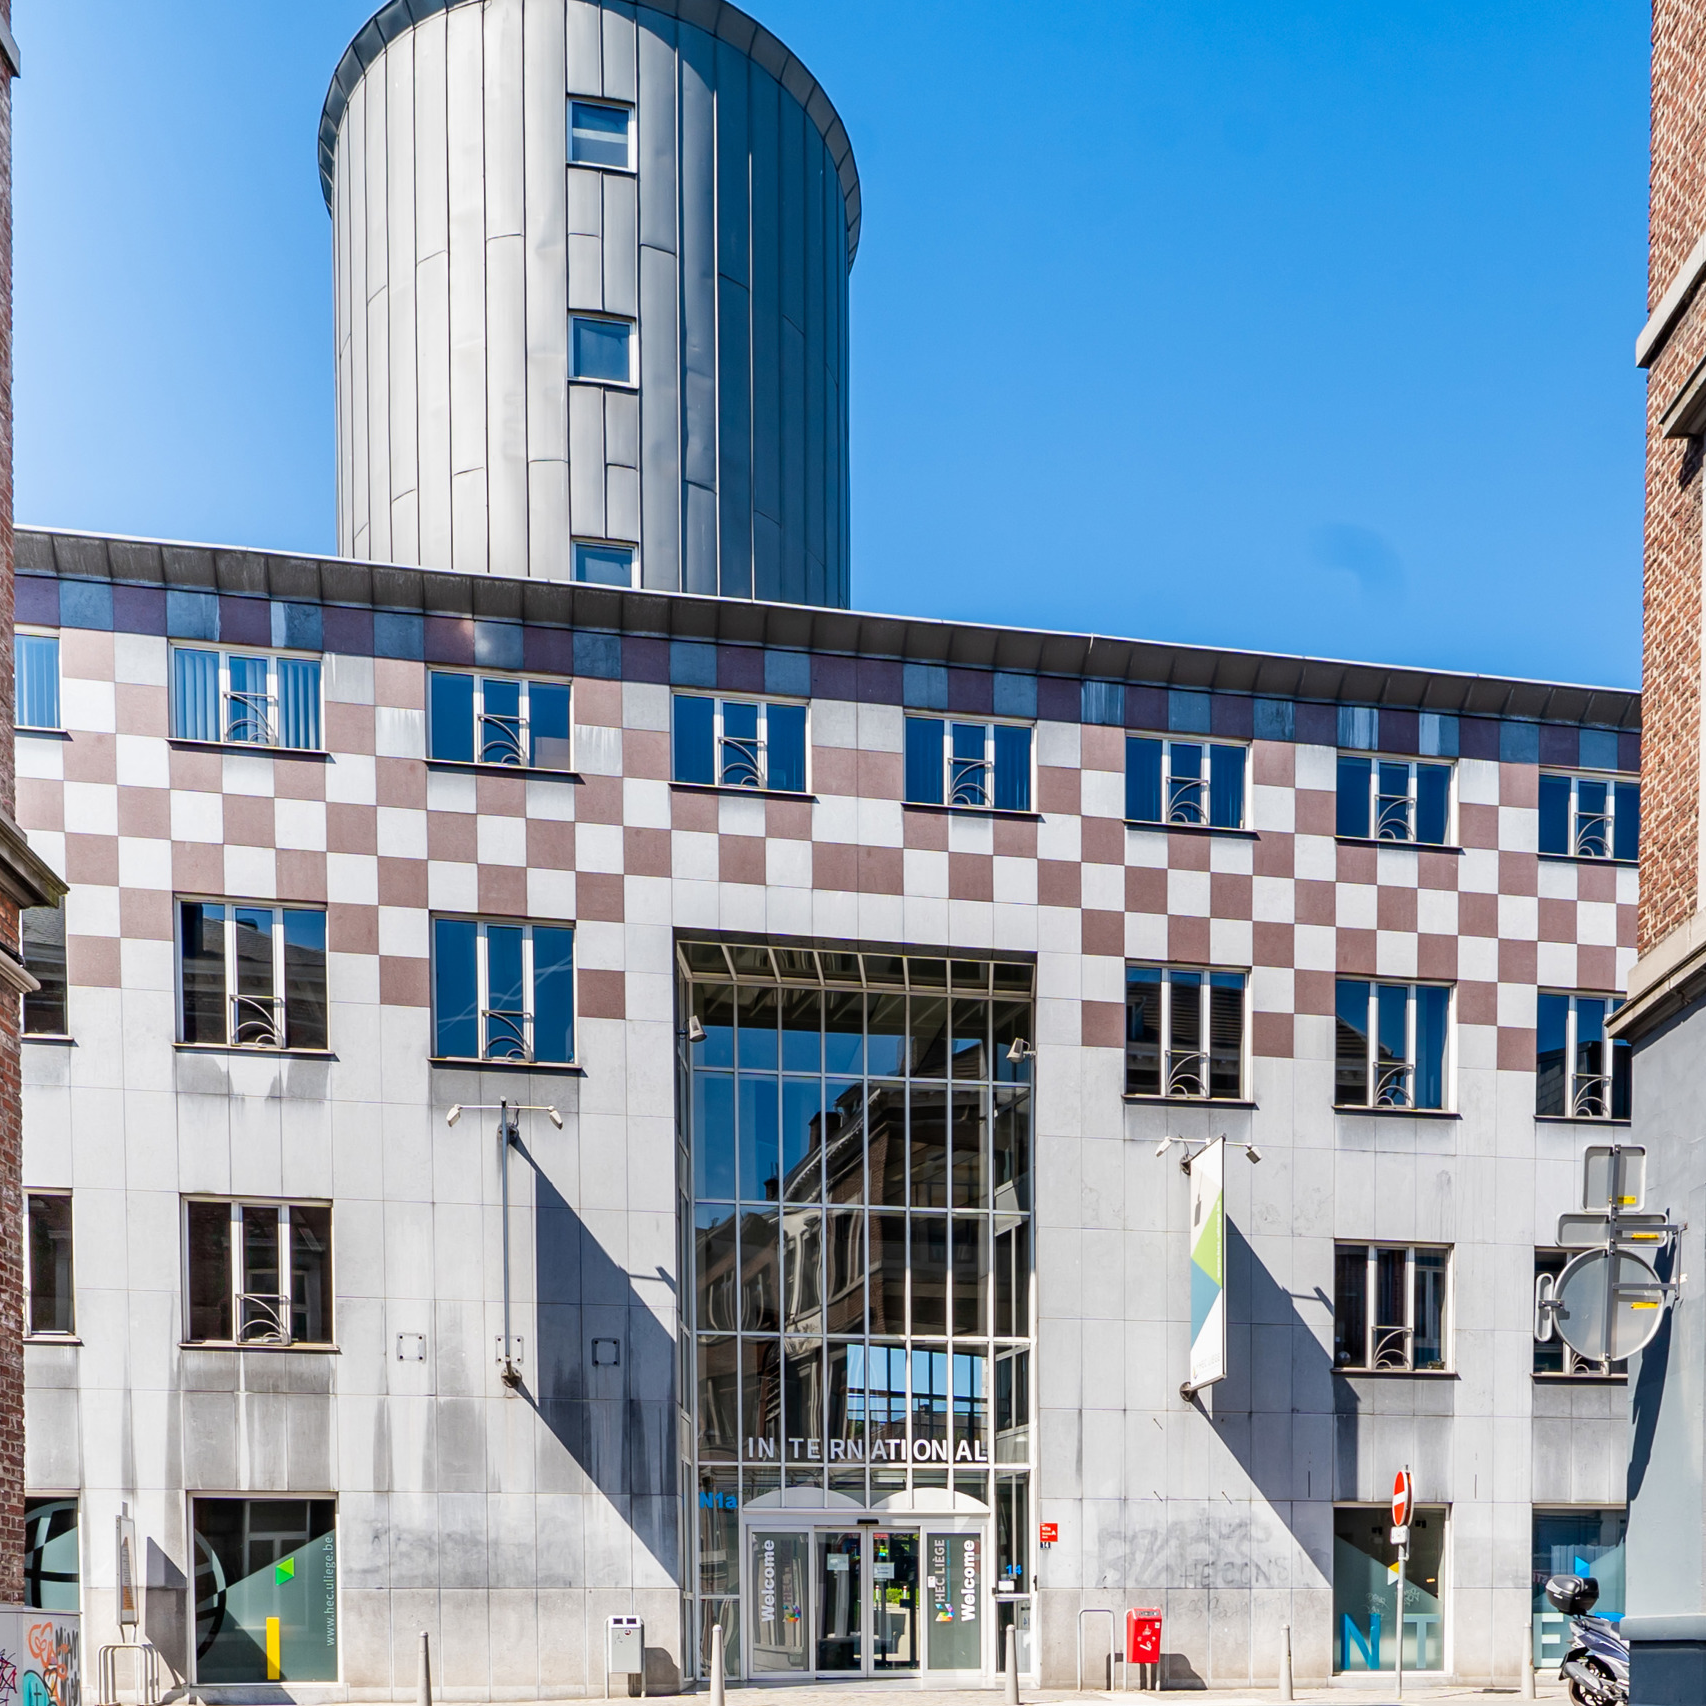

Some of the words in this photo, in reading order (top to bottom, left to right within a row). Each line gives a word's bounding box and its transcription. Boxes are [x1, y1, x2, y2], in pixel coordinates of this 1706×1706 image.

[698, 1491, 738, 1509] N1a
[932, 1539, 945, 1574] LIÈGE
[1005, 1564, 1023, 1576] 14
[323, 1536, 335, 1647] www.hec.uliege.be
[761, 1539, 775, 1622] Welcome
[934, 1577, 945, 1603] HEC
[960, 1539, 975, 1622] Welcome
